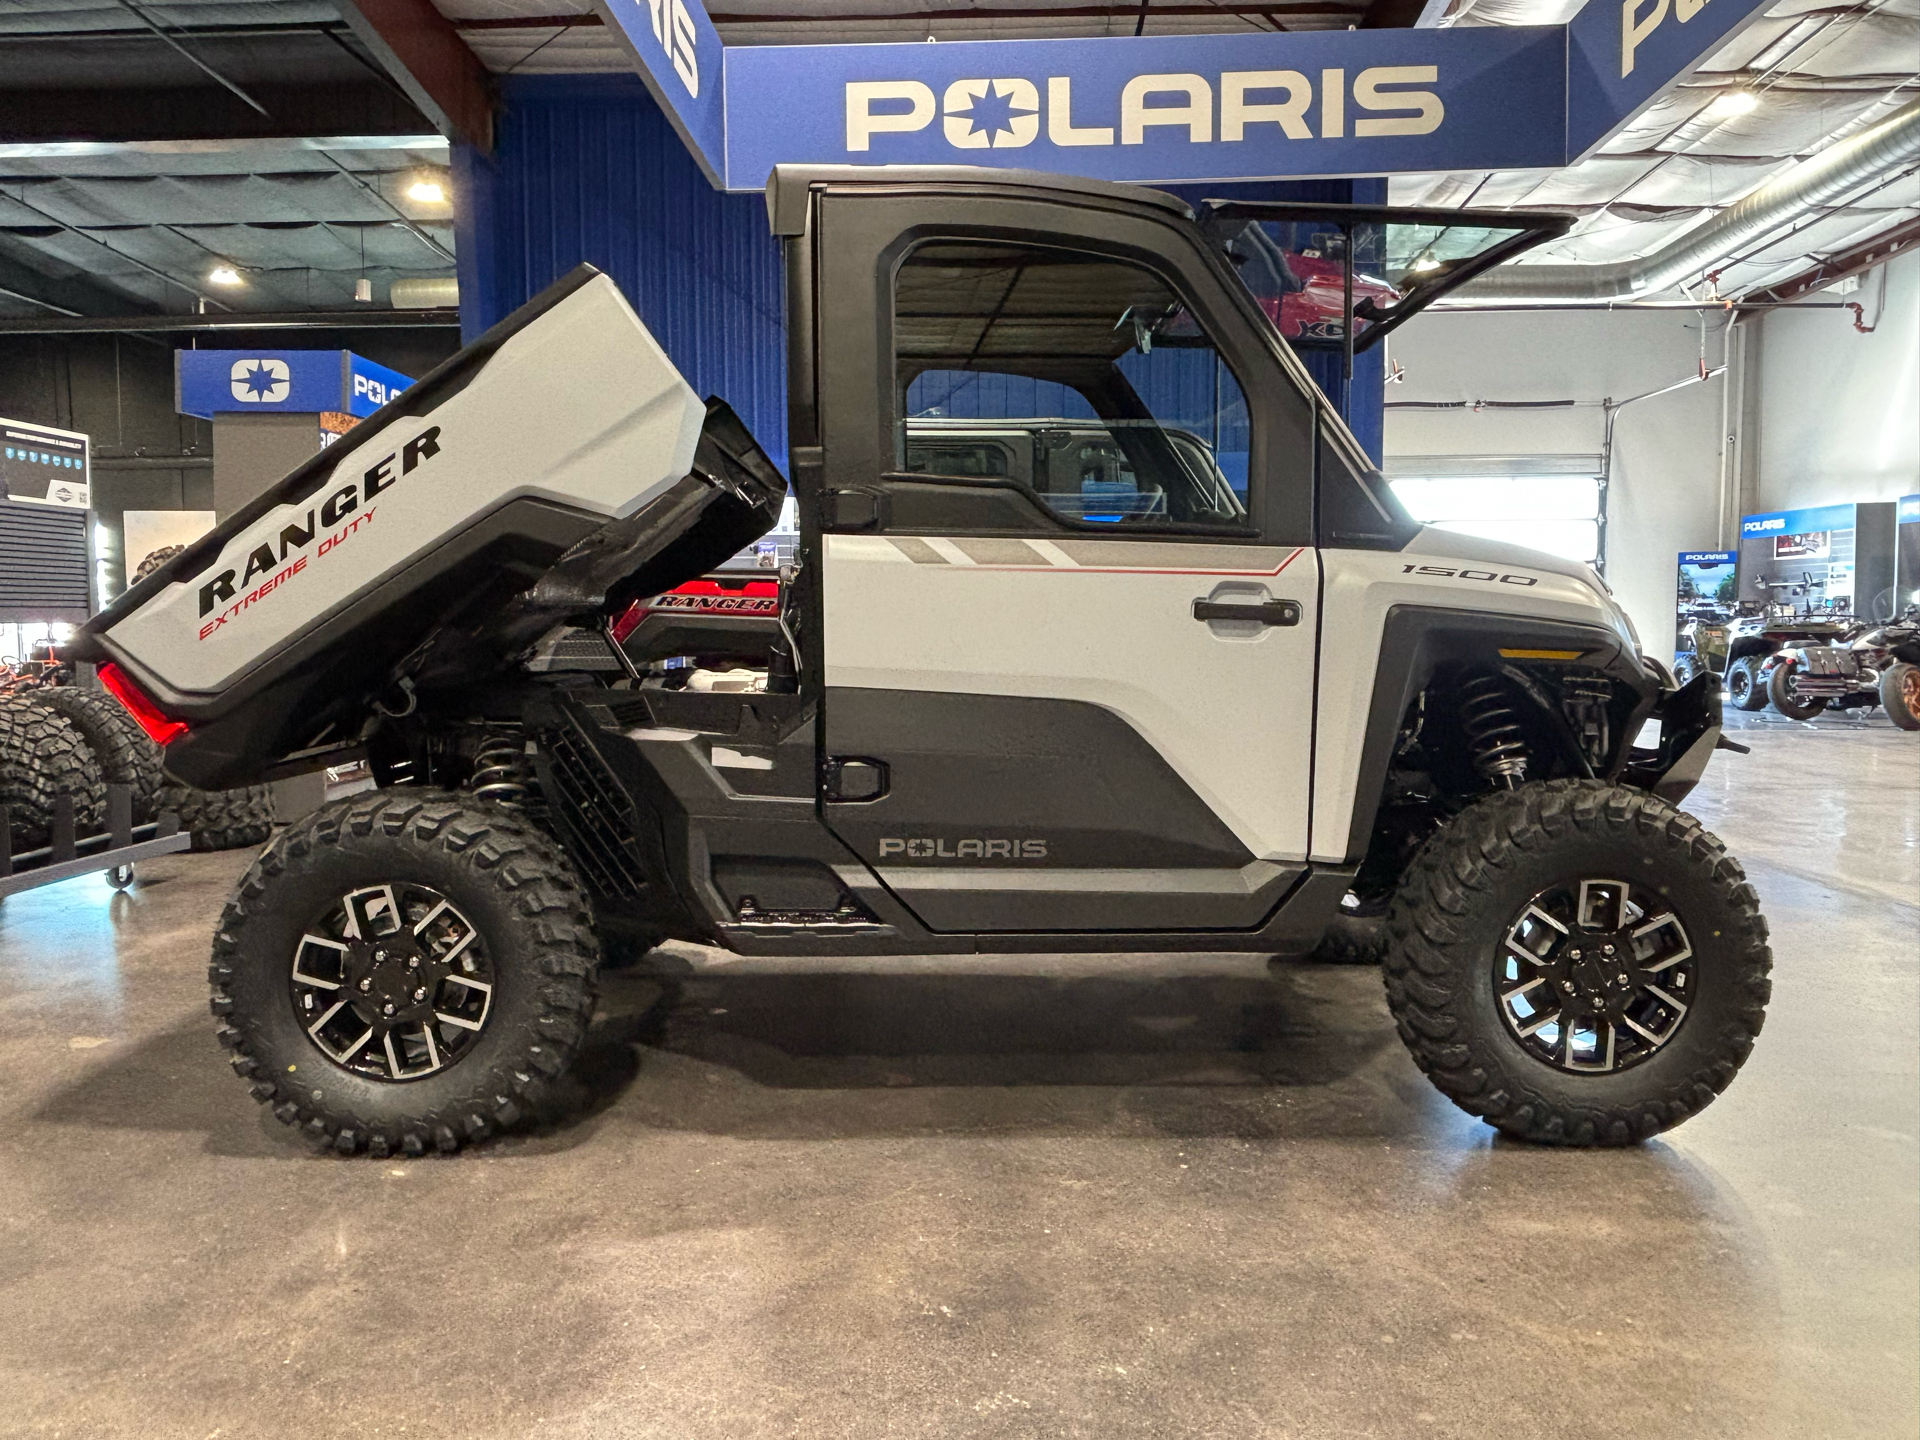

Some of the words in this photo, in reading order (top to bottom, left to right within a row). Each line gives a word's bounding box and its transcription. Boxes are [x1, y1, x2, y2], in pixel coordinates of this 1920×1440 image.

[845, 64, 1445, 151] POLARIS
[198, 425, 442, 619] RANGER
[1744, 518, 1786, 532] POLARIS
[1685, 553, 1729, 561] POLARIS
[198, 555, 308, 641] EXTREME
[317, 507, 377, 559] DUTY
[1402, 564, 1538, 587] 1500
[655, 595, 776, 611] RANGER
[878, 837, 1048, 858] POLARIS
